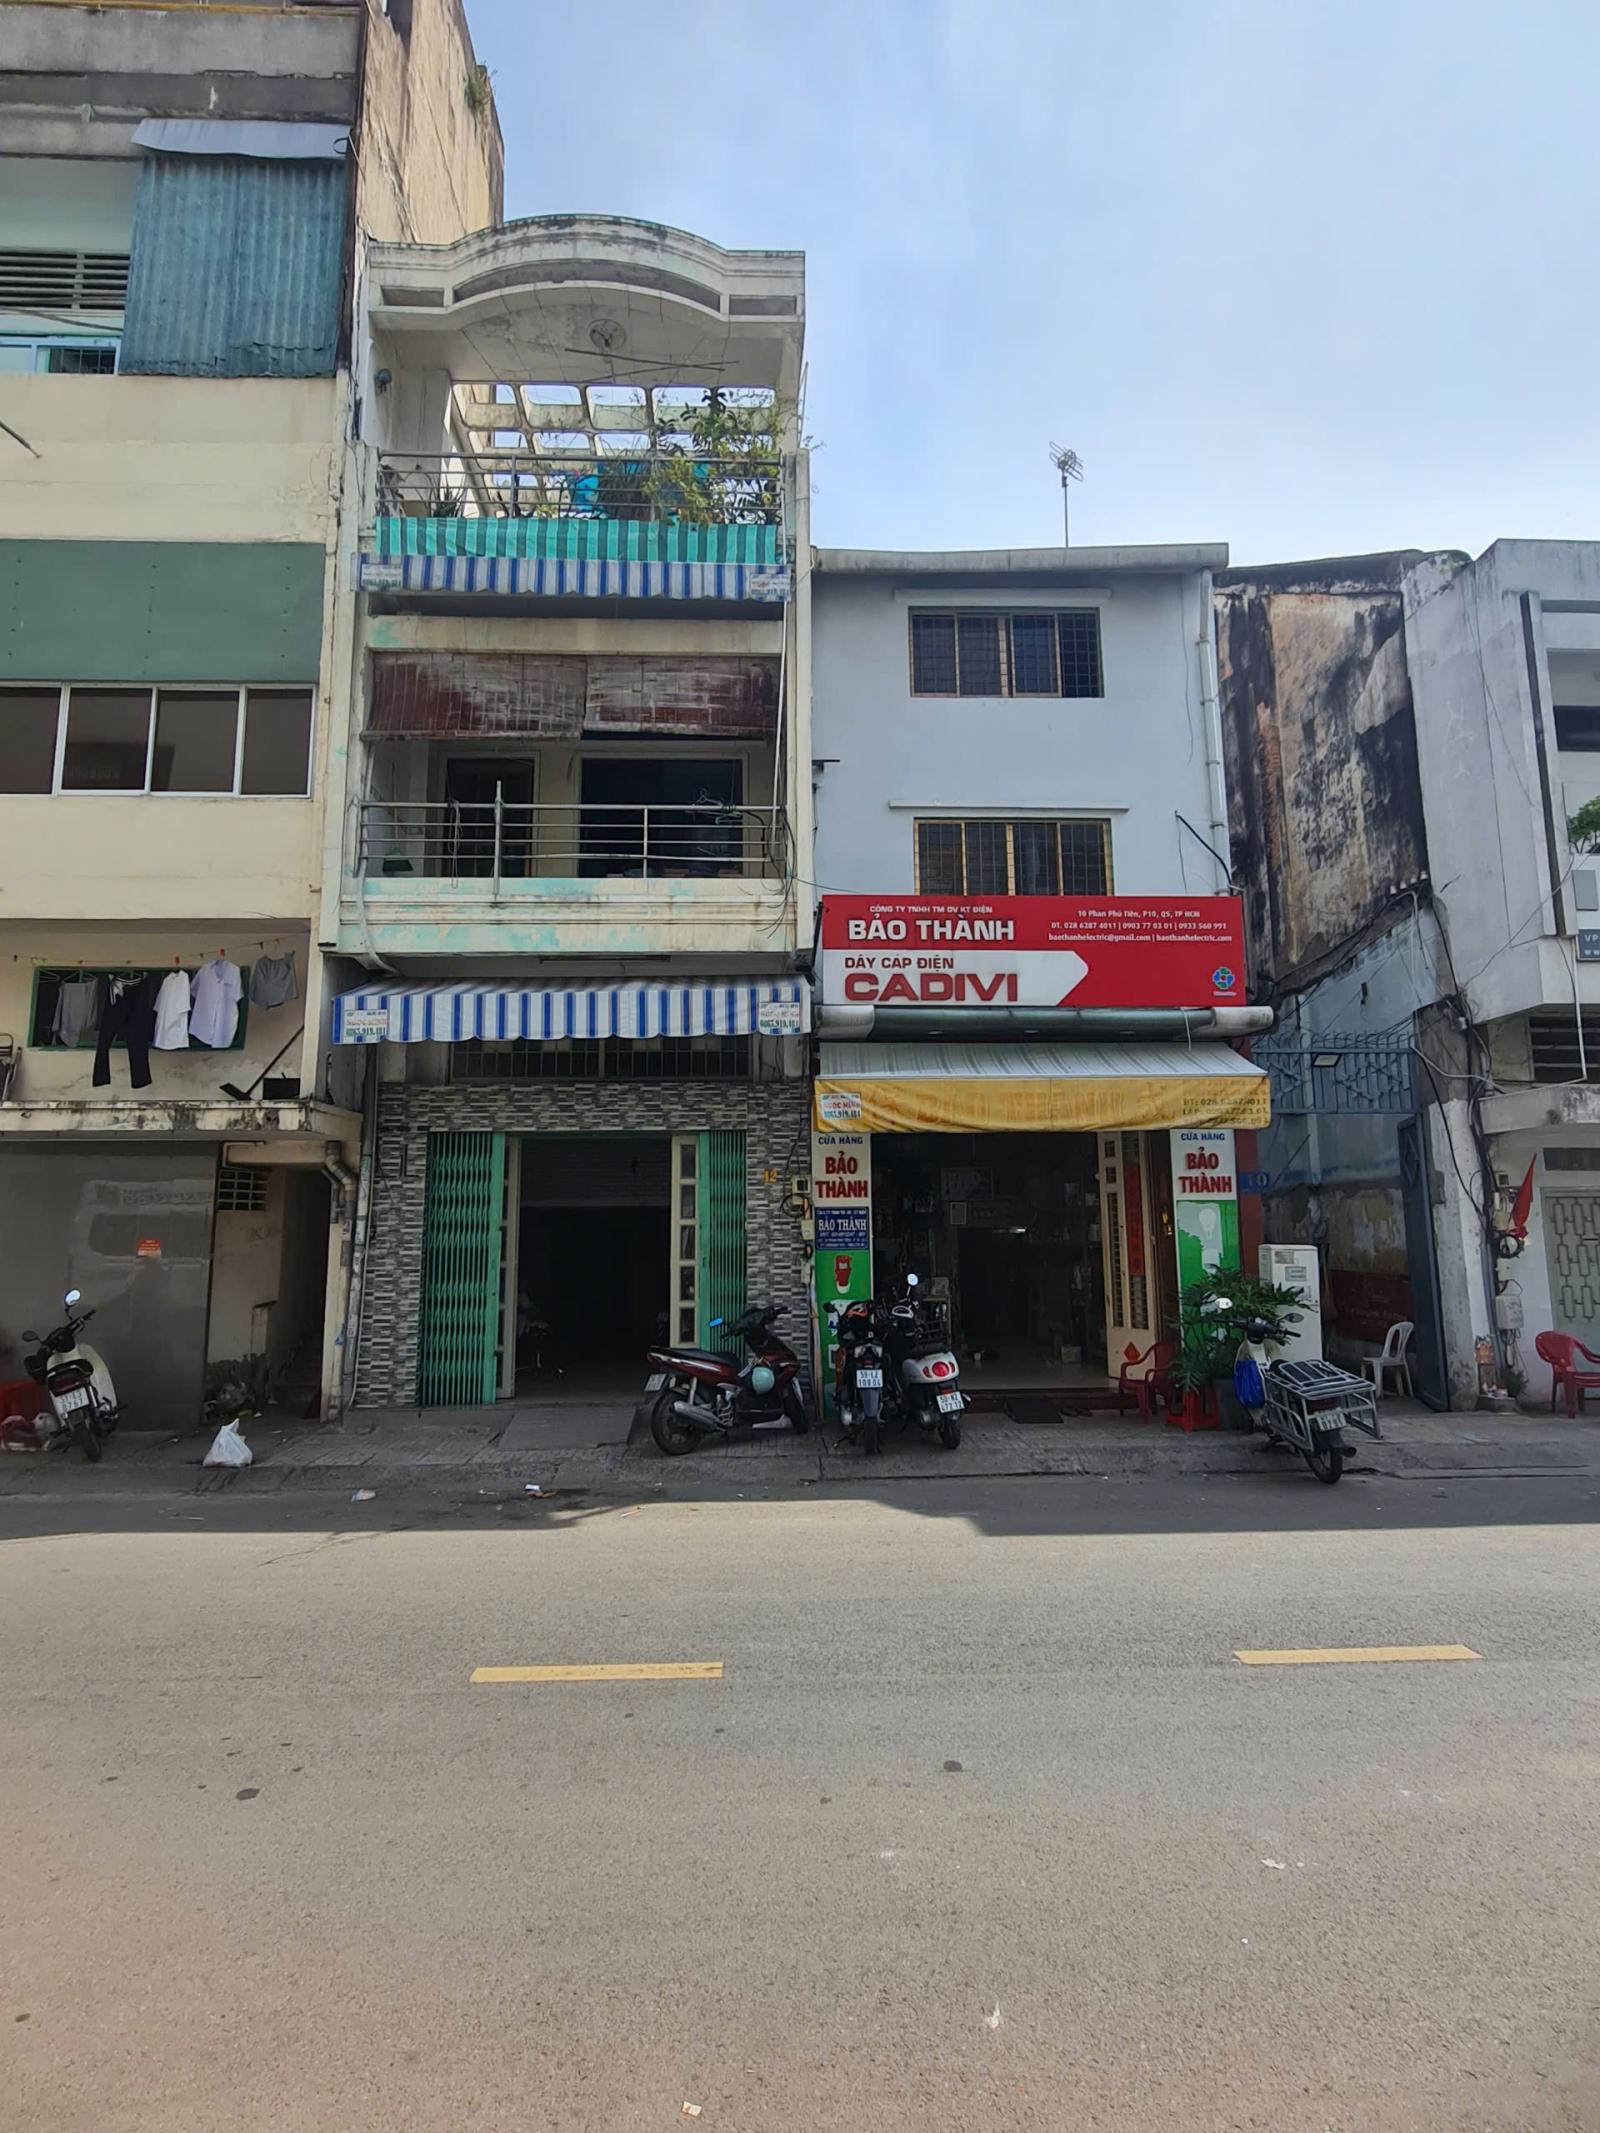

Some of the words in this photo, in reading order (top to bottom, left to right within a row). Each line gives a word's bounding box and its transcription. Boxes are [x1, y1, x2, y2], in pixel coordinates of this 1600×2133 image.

[895, 905, 906, 913] TY
[907, 905, 930, 913] TNHH
[932, 905, 945, 913] TM
[1077, 910, 1087, 918] 10
[1088, 910, 1107, 918] Phan
[1142, 910, 1159, 919] P10,
[1174, 910, 1183, 918] TP
[1184, 910, 1201, 918] HCM
[847, 913, 907, 940] BẢO
[915, 914, 1015, 940] THÀNH
[1098, 922, 1117, 930] 4011
[1122, 922, 1140, 930] 0903
[1142, 922, 1151, 930] 77
[1152, 922, 1162, 930] 03
[1163, 922, 1173, 930] 01
[1178, 922, 1197, 930] 0933
[1198, 922, 1212, 930] 560
[1048, 932, 1151, 942] baothanhelectric@gmail.com
[1156, 934, 1232, 942] baothanhelectric.com
[845, 954, 876, 969] DÂY
[881, 954, 912, 969] CÁP
[916, 954, 954, 972] ĐIỆN
[845, 973, 1018, 1001] CADIVI
[818, 1134, 836, 1144] CỬA
[838, 1135, 863, 1144] HÀNG
[1180, 1131, 1198, 1141] CỬA
[1201, 1131, 1225, 1141] HÀNG
[825, 1150, 858, 1174] BẢO
[1185, 1146, 1219, 1170] BẢO
[815, 1176, 868, 1198] THÀNH
[1178, 1172, 1232, 1193] THÀNH
